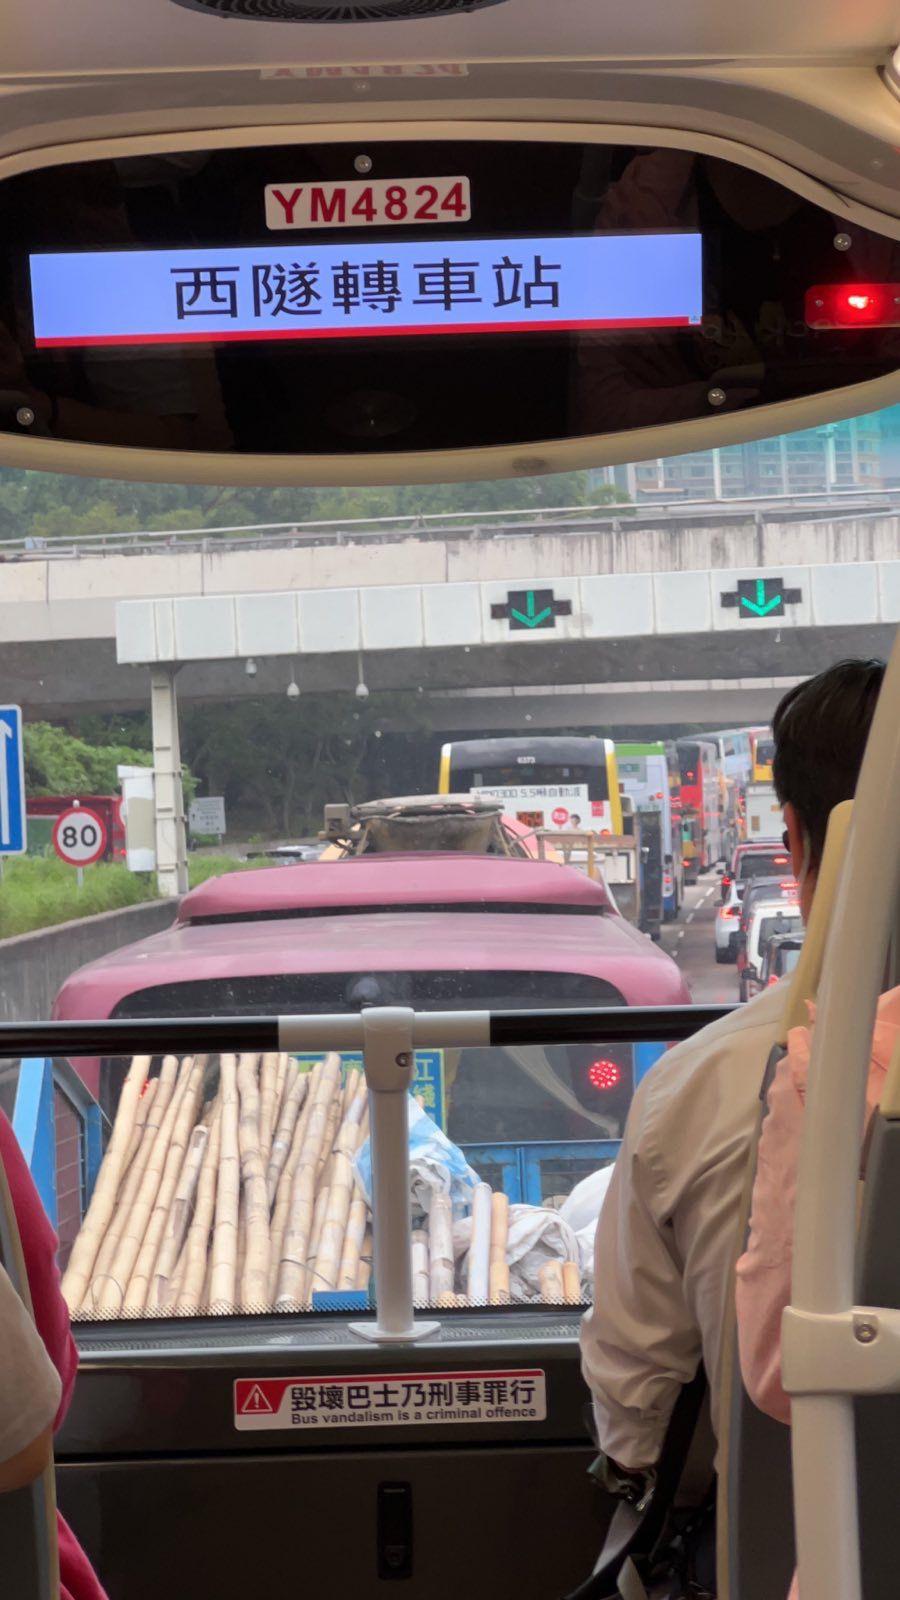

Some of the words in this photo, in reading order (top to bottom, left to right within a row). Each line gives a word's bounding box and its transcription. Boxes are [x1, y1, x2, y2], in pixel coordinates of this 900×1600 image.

[271, 183, 467, 224] YM4824
[170, 255, 562, 320] 西隧轉車站
[63, 825, 97, 848] 80
[291, 1379, 536, 1411] 毀壞巴士乃刑事罪行
[292, 1413, 318, 1425] Bus
[323, 1411, 394, 1424] vandalism
[398, 1410, 410, 1421] is
[414, 1412, 422, 1421] a
[426, 1408, 482, 1420] criminal
[485, 1406, 537, 1419] offence
